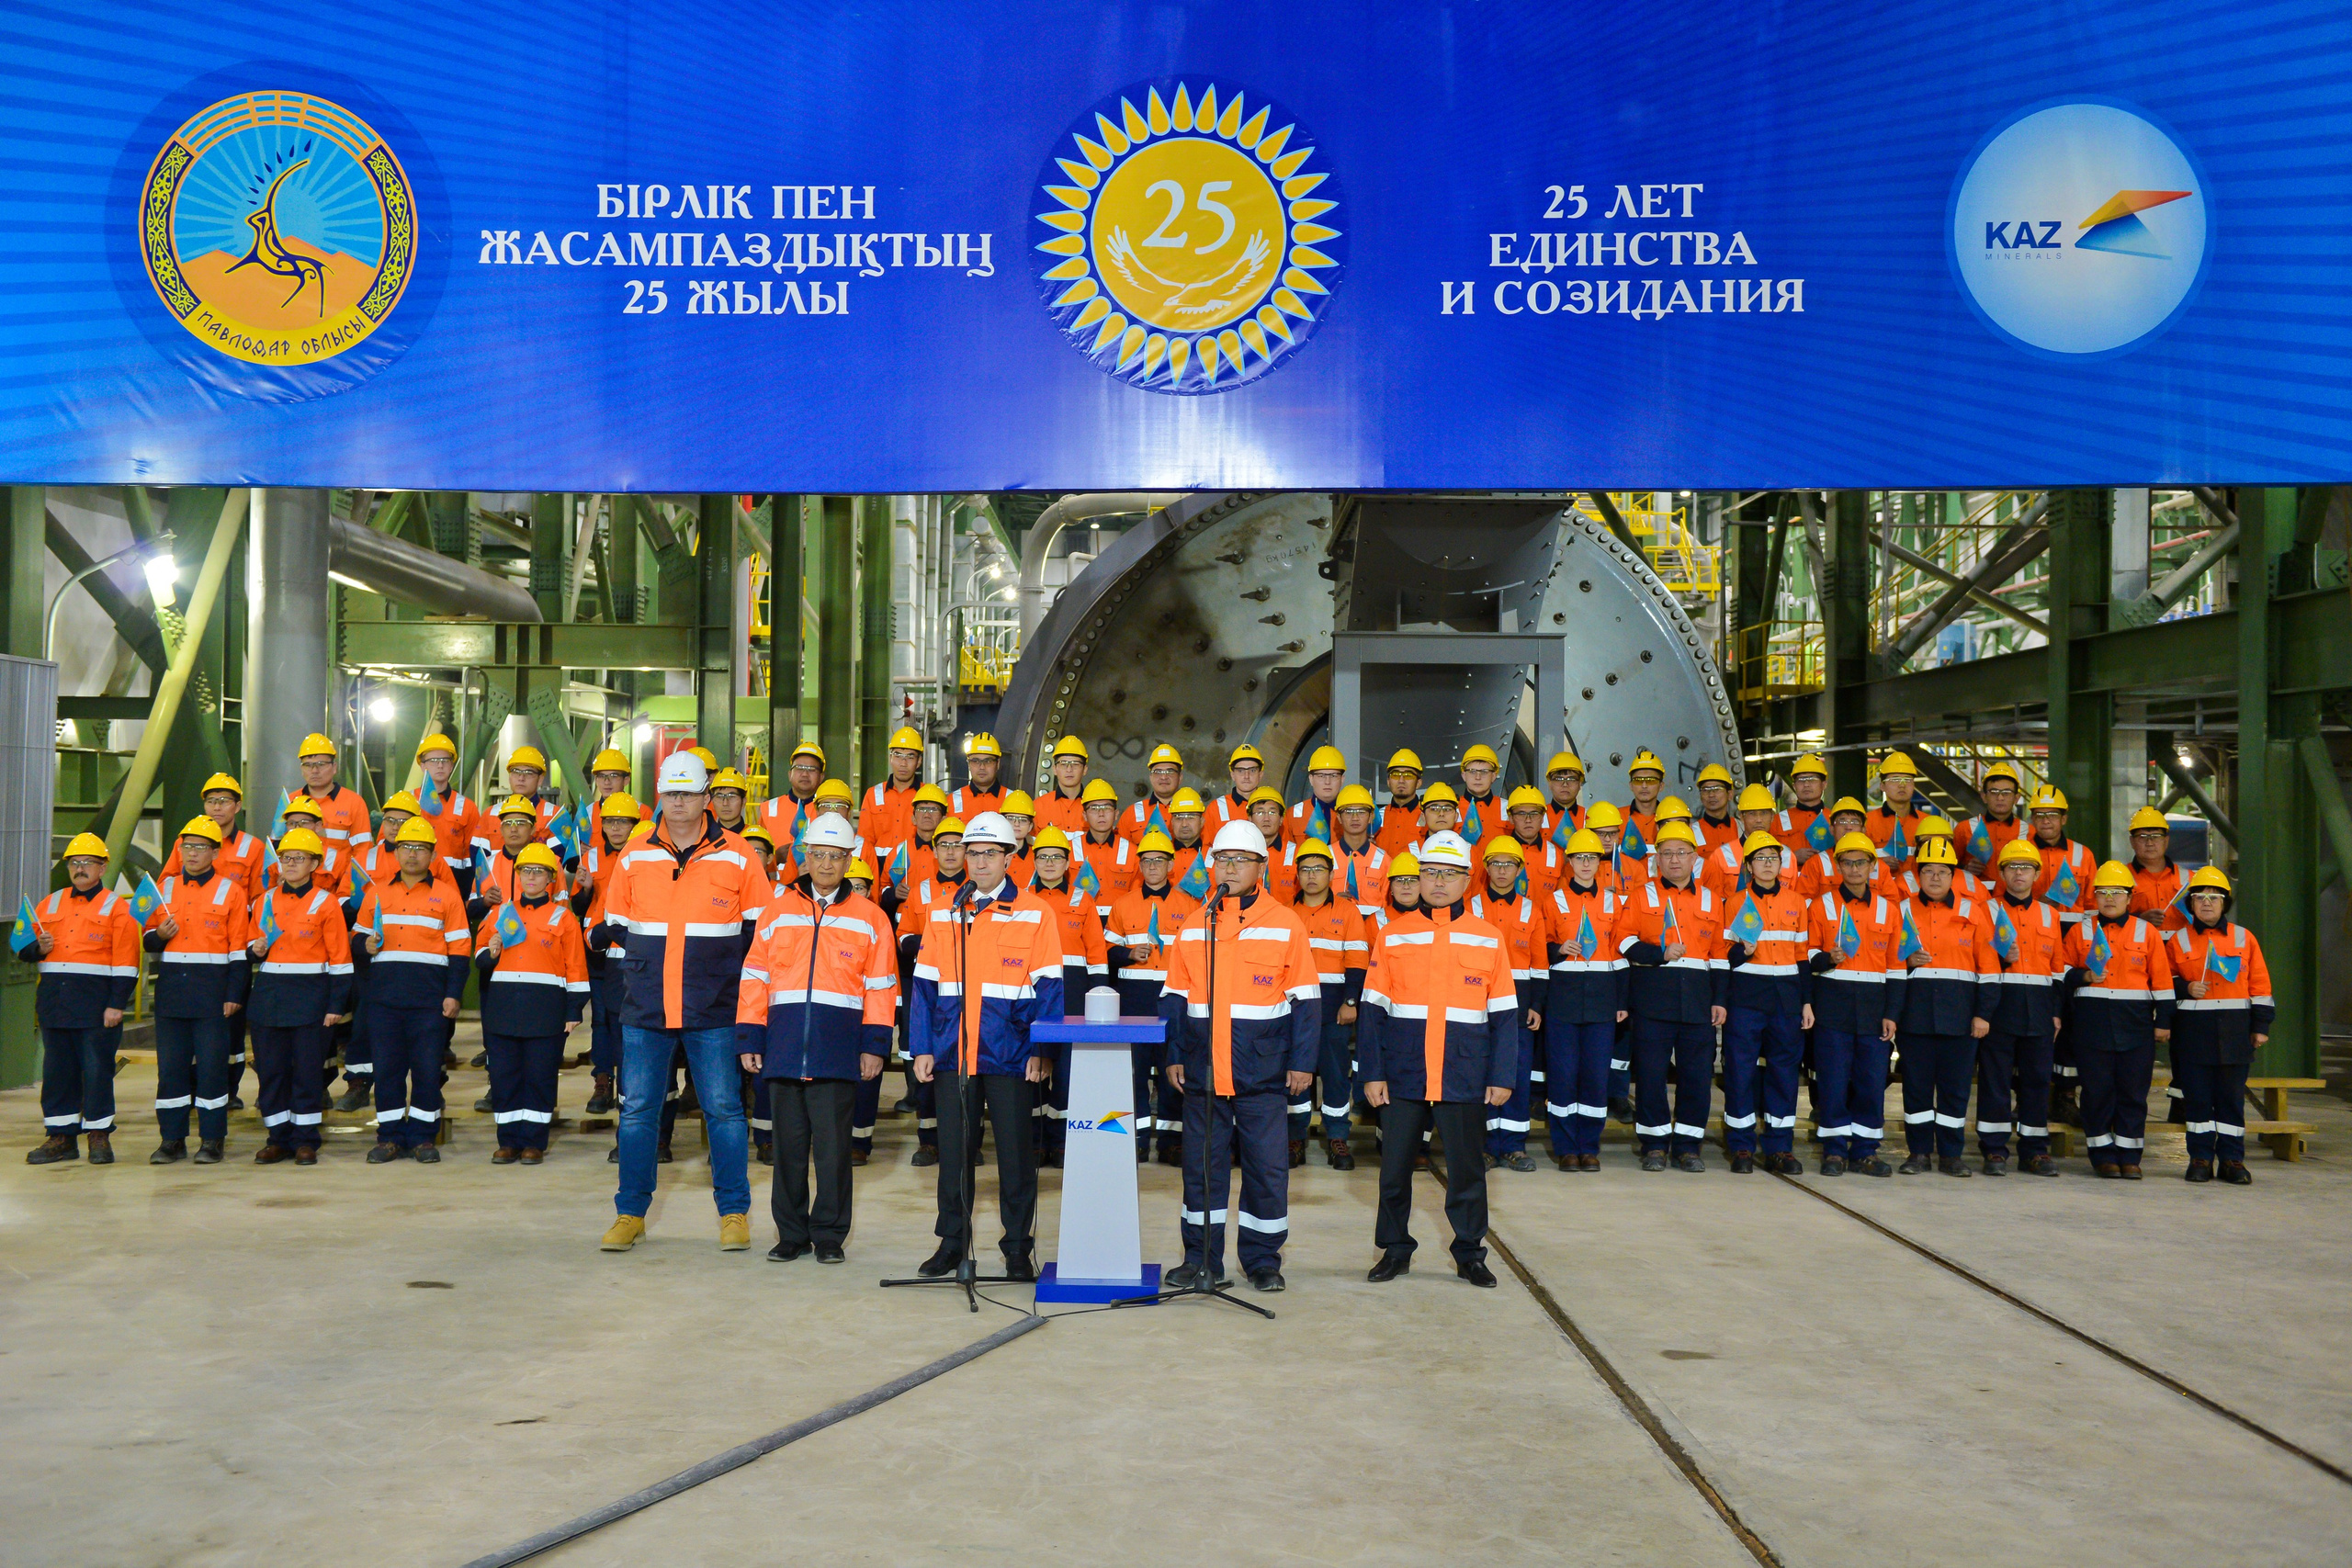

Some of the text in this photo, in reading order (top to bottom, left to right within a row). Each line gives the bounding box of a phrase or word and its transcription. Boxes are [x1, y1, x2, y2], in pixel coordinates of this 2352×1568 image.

[597, 183, 876, 220] БІРЛІК ПЕН
[1141, 179, 1236, 255] 25
[1544, 183, 1703, 220] 25 ЛЕТ
[1489, 231, 1758, 270] ЕДИНСТВА
[1985, 220, 2062, 249] KAZ
[479, 231, 995, 277] ЖАСАМПАЗДЫҚТЫҢ
[623, 279, 850, 315] 25 ЖЫЛЫ
[1442, 279, 1805, 321] И СОЗИДАНИЯ
[197, 310, 367, 357] ПАВЛОДАР ОБЛЫСЫ
[712, 897, 729, 905] KAZ
[541, 938, 553, 946] KAZ
[840, 950, 853, 958] KAZ
[1003, 957, 1023, 965] KAZ
[1253, 975, 1273, 985] KAZ
[1464, 976, 1483, 985] KAZ
[1069, 1120, 1093, 1130] KAZ
